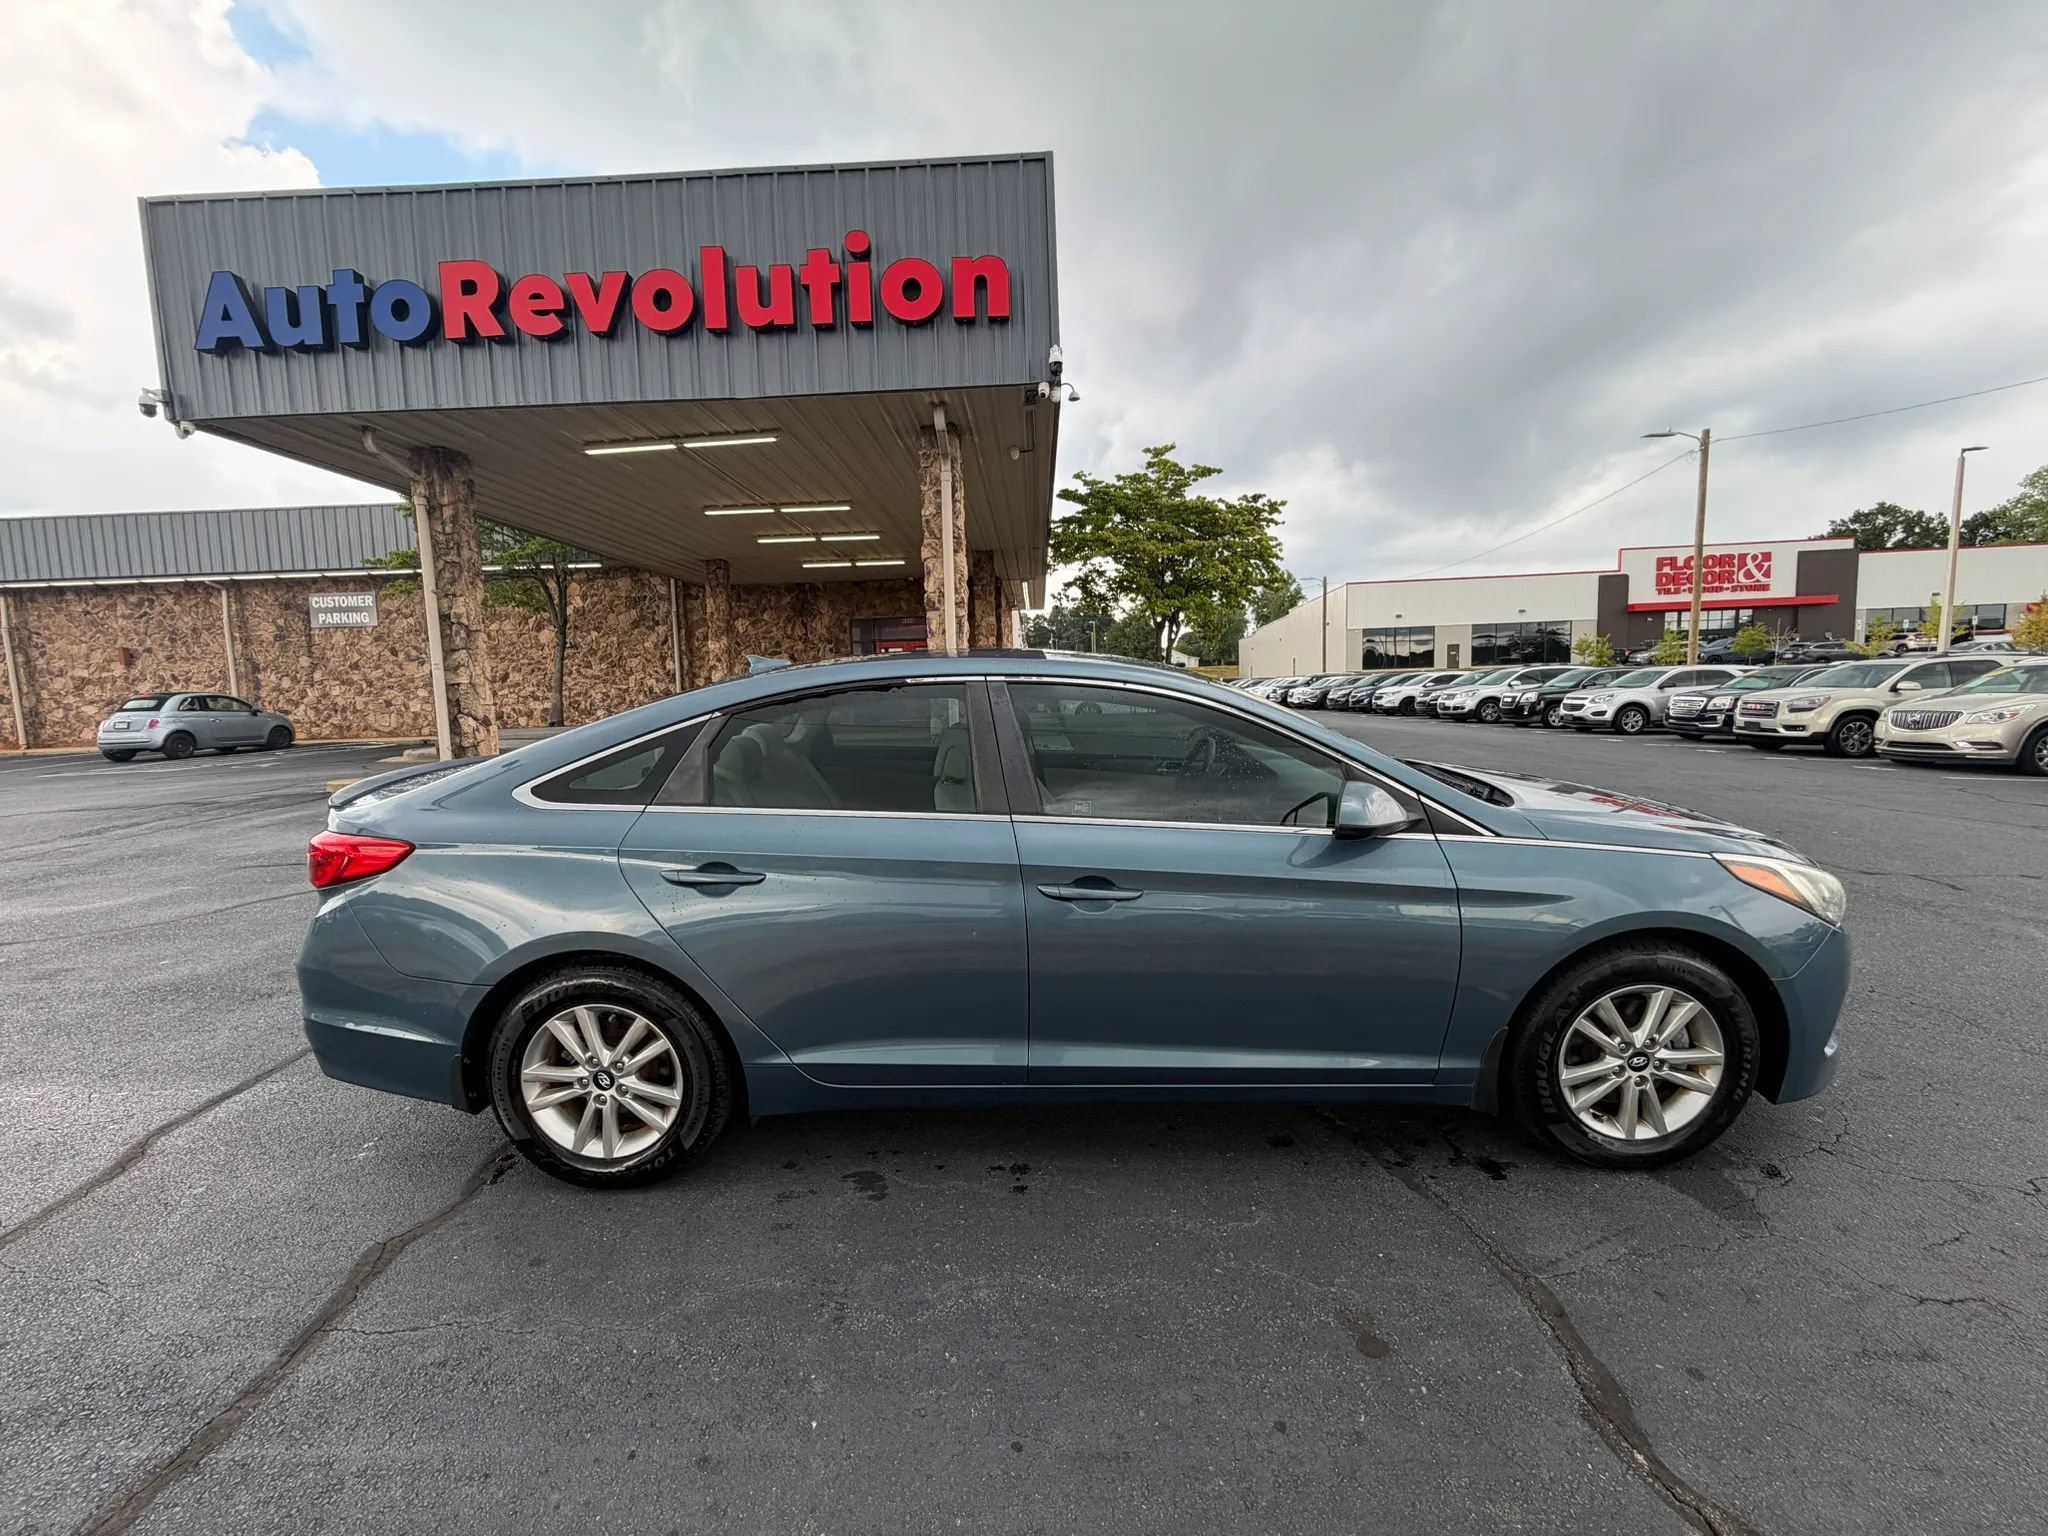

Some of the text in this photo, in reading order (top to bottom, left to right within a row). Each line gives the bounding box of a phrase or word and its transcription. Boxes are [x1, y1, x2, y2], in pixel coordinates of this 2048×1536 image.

[1656, 551, 1772, 583] FLOOR &
[312, 595, 373, 608] CUSTOMER
[318, 612, 370, 624] PARKING
